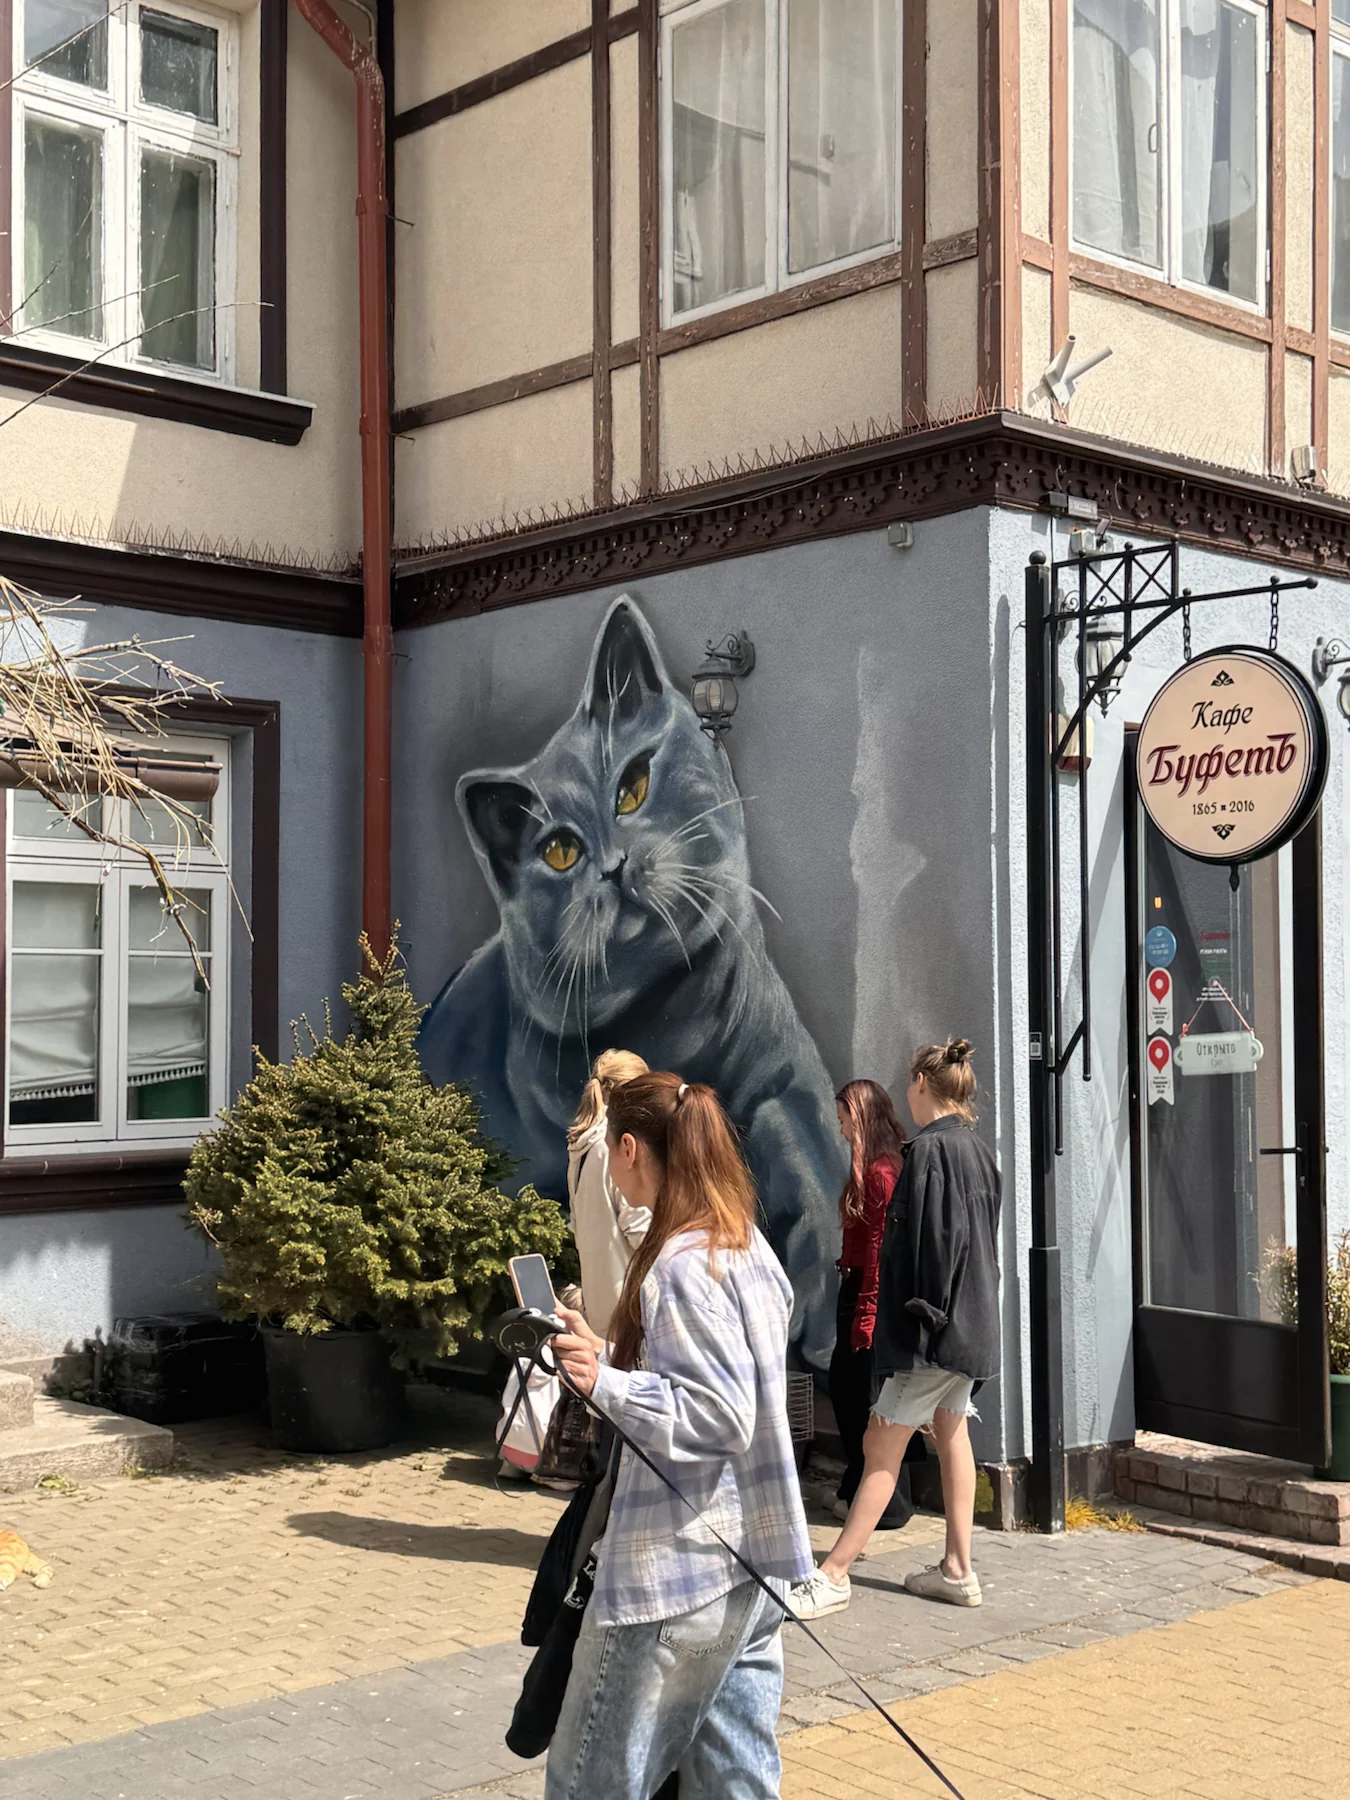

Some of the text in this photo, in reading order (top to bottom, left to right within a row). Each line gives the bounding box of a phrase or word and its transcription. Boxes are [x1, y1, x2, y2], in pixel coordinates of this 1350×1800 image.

[1191, 700, 1254, 735] Кафе
[1147, 732, 1297, 798] Буфетъ
[1192, 799, 1255, 816] 1865 2016
